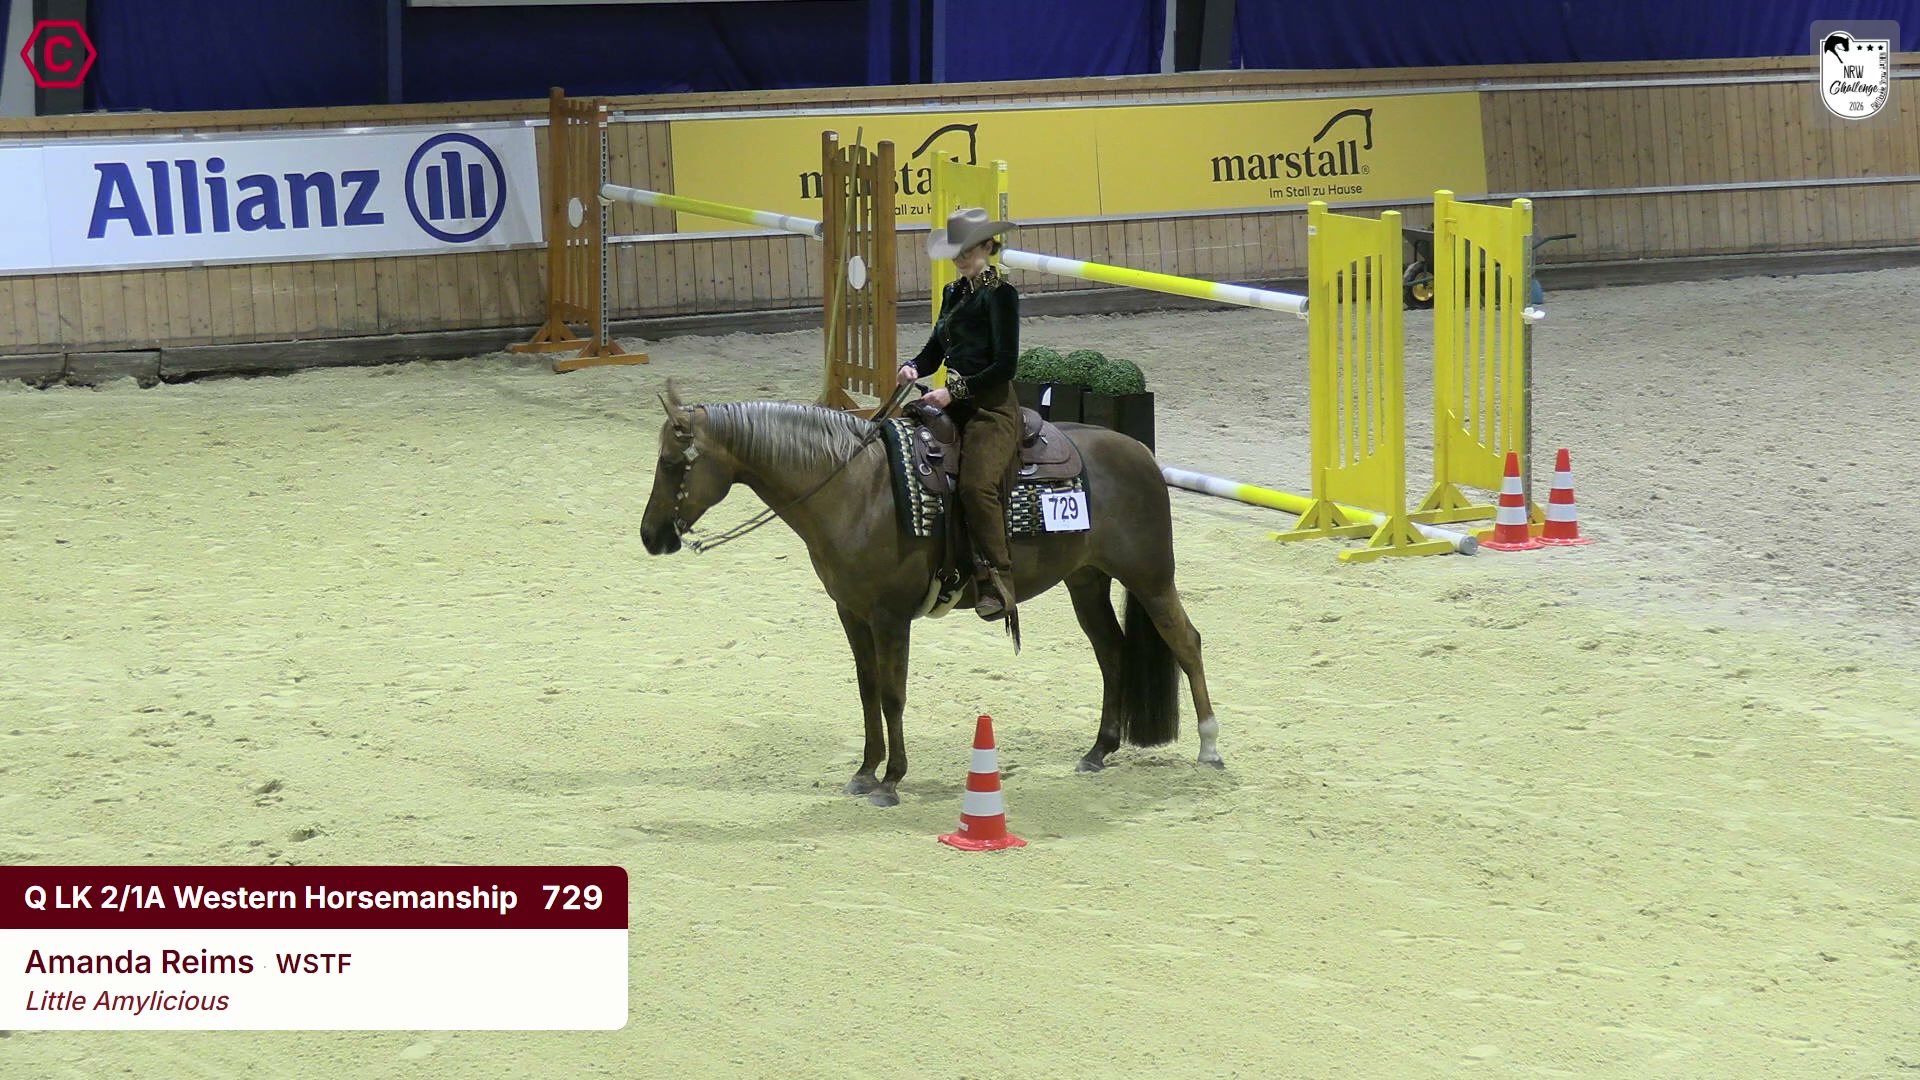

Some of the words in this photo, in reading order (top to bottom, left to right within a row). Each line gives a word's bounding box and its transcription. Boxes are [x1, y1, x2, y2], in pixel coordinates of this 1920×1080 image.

[87, 157, 385, 240] Allianz
[1269, 187, 1283, 199] Im
[1286, 186, 1310, 198] Stall
[1313, 187, 1326, 197] zu
[1328, 184, 1363, 196] Hause
[910, 206, 924, 215] zu
[1049, 496, 1079, 520] 729
